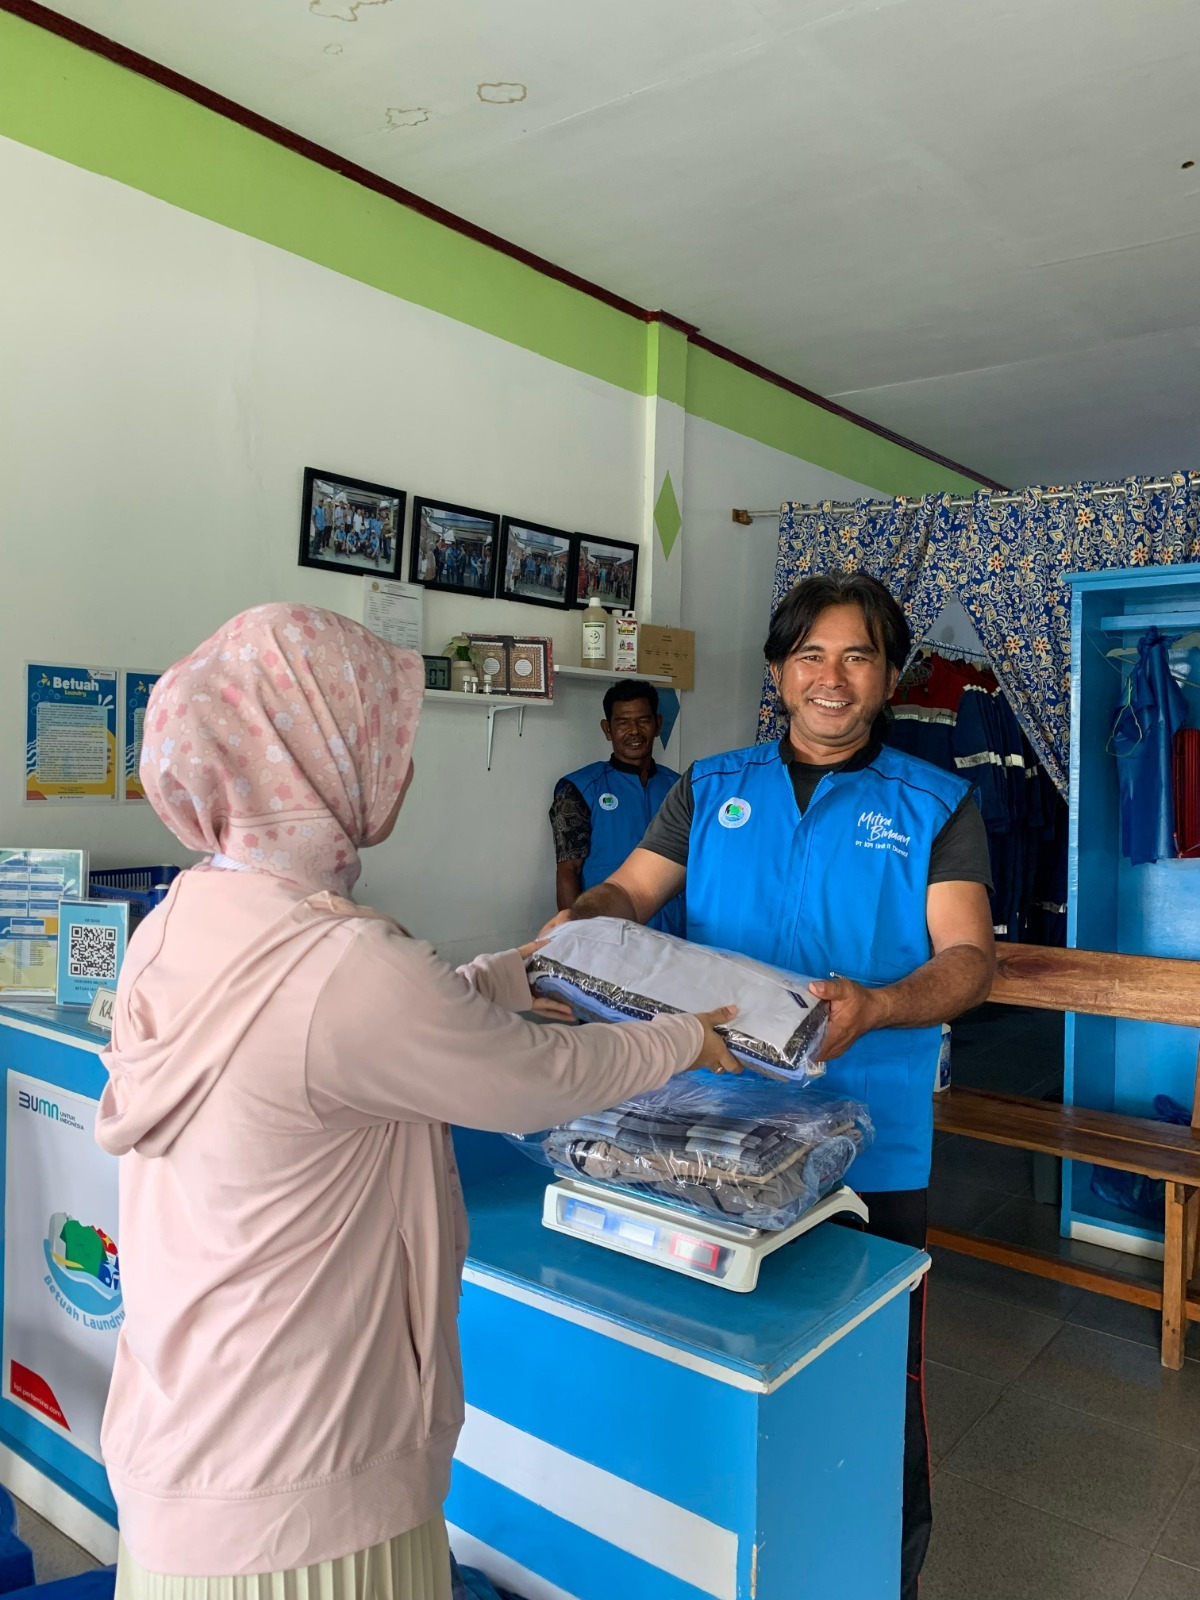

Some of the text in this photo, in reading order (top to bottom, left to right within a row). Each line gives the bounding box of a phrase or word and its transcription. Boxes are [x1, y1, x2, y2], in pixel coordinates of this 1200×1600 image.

[53, 677, 99, 691] Betuah
[857, 811, 892, 830] Mitra
[867, 825, 911, 846] Binaan
[99, 999, 113, 1020] KA
[60, 1111, 76, 1121] UNTUK
[60, 1117, 85, 1130] INDONESIA
[44, 1275, 79, 1321] Betuah
